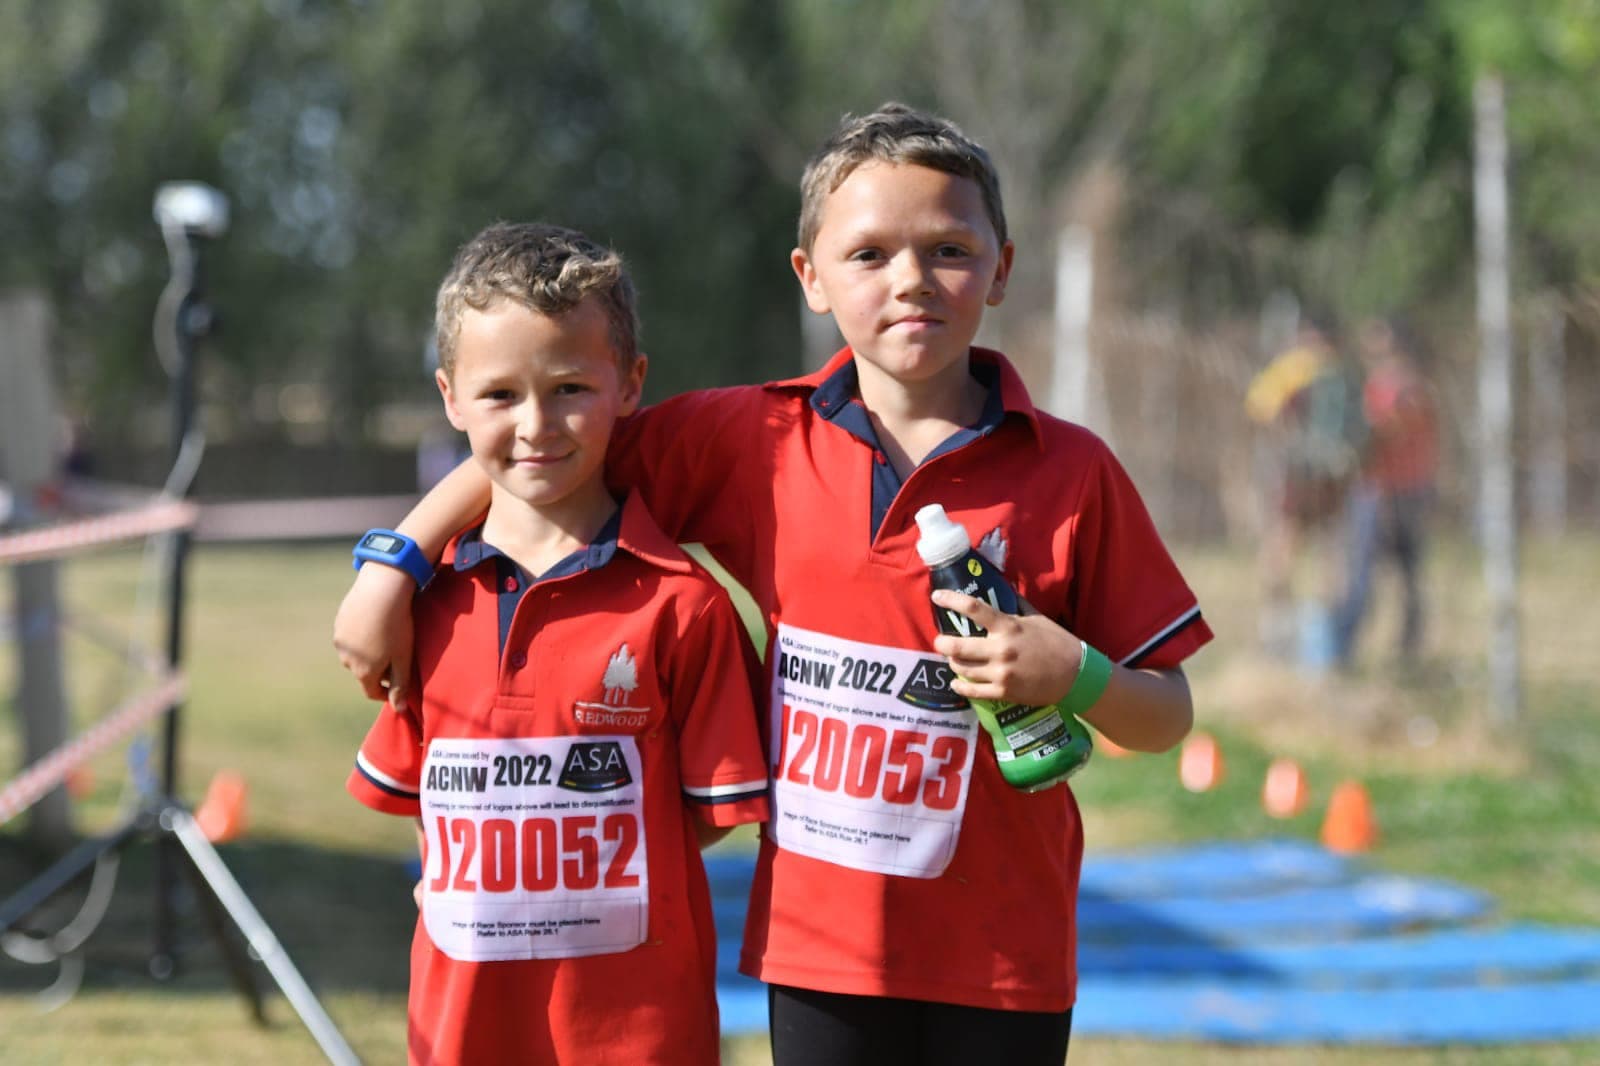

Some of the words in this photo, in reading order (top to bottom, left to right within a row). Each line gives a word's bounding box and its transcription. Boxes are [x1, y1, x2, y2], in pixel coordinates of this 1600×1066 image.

[778, 651, 836, 690] ACNW
[838, 656, 897, 695] 2022
[911, 664, 952, 692] AS
[575, 709, 647, 726] REDWOOD
[852, 707, 873, 717] above
[876, 711, 888, 719] will
[889, 713, 905, 722] lead
[916, 717, 971, 731] disqualification
[481, 752, 489, 761] by
[568, 747, 622, 772] ASA
[773, 705, 968, 812] J20053
[427, 765, 488, 792] ACNW
[493, 754, 551, 787] 2022
[493, 803, 512, 813] logos
[554, 801, 570, 809] lead
[581, 798, 635, 811] disqualification
[859, 829, 867, 837] be
[869, 830, 894, 841] placed
[895, 834, 911, 843] here
[430, 813, 640, 893] J20052
[477, 929, 496, 937] Refer
[524, 929, 541, 937] Rule
[497, 921, 526, 929] Sponsor
[529, 919, 546, 927] must
[559, 918, 582, 928] placed
